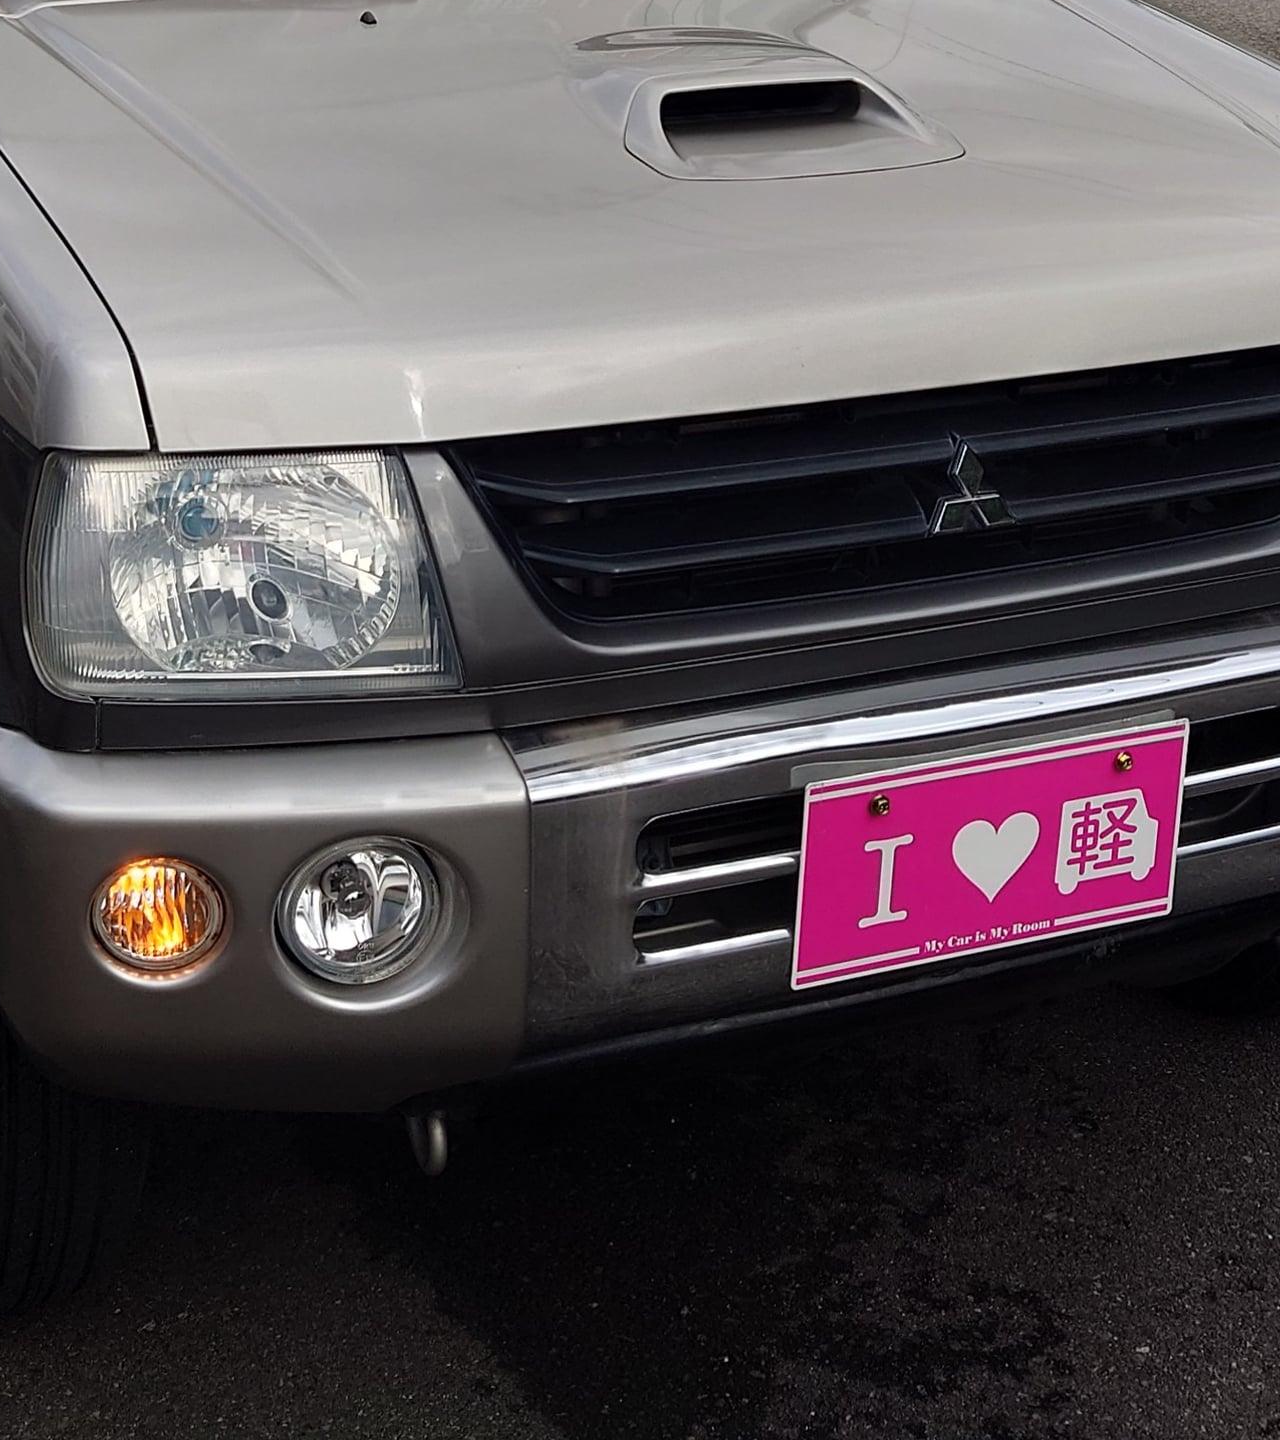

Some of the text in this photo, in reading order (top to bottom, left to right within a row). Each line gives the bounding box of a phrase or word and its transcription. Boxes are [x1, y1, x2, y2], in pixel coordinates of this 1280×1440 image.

[858, 797, 1139, 929] I 軽
[924, 919, 1051, 953] My Car is My Room
